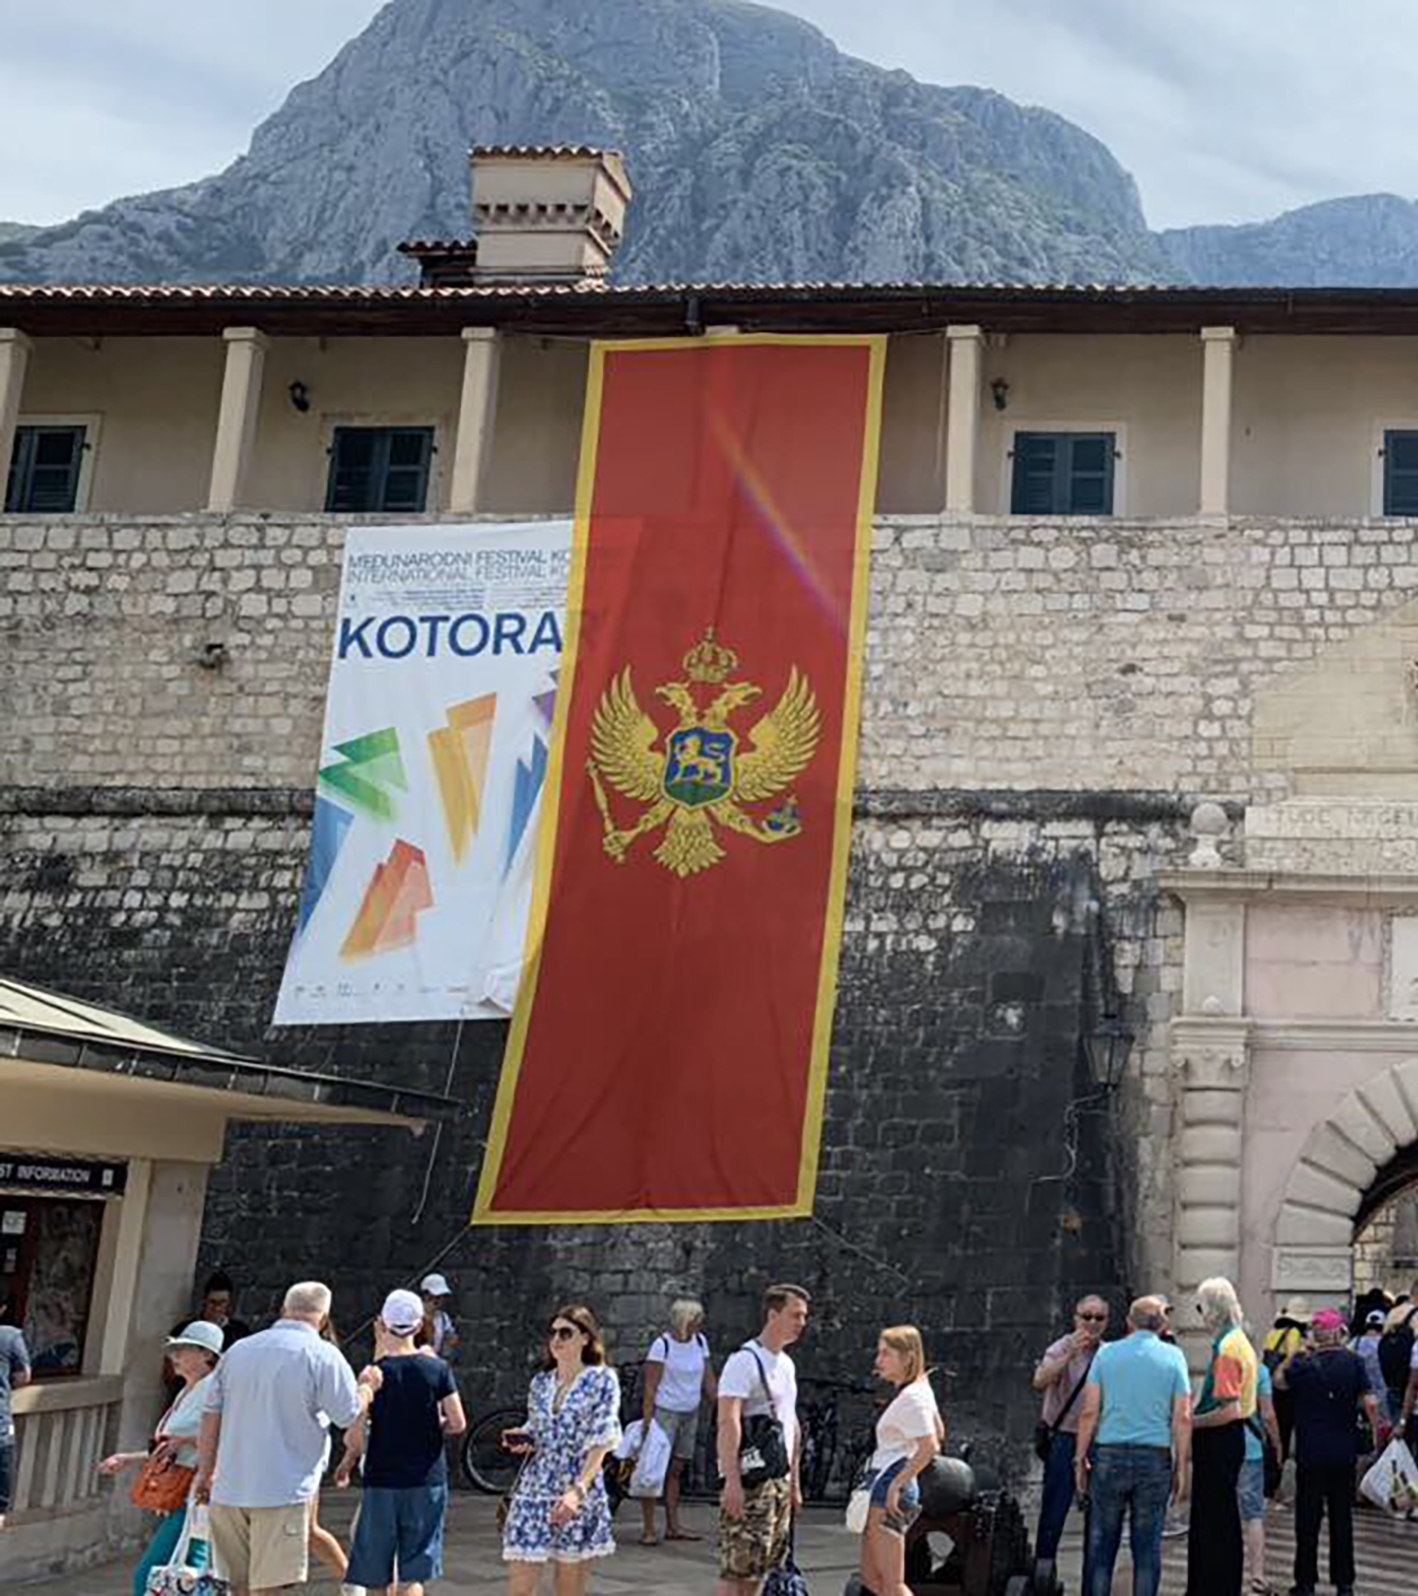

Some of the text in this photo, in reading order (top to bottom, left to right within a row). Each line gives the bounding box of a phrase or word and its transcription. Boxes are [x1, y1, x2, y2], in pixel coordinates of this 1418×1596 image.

[476, 549, 546, 566] FESTIVAL
[346, 568, 468, 584] INTERNATIONAL
[475, 566, 545, 581] FESTIVAL
[17, 1165, 91, 1182] INFORMATION
